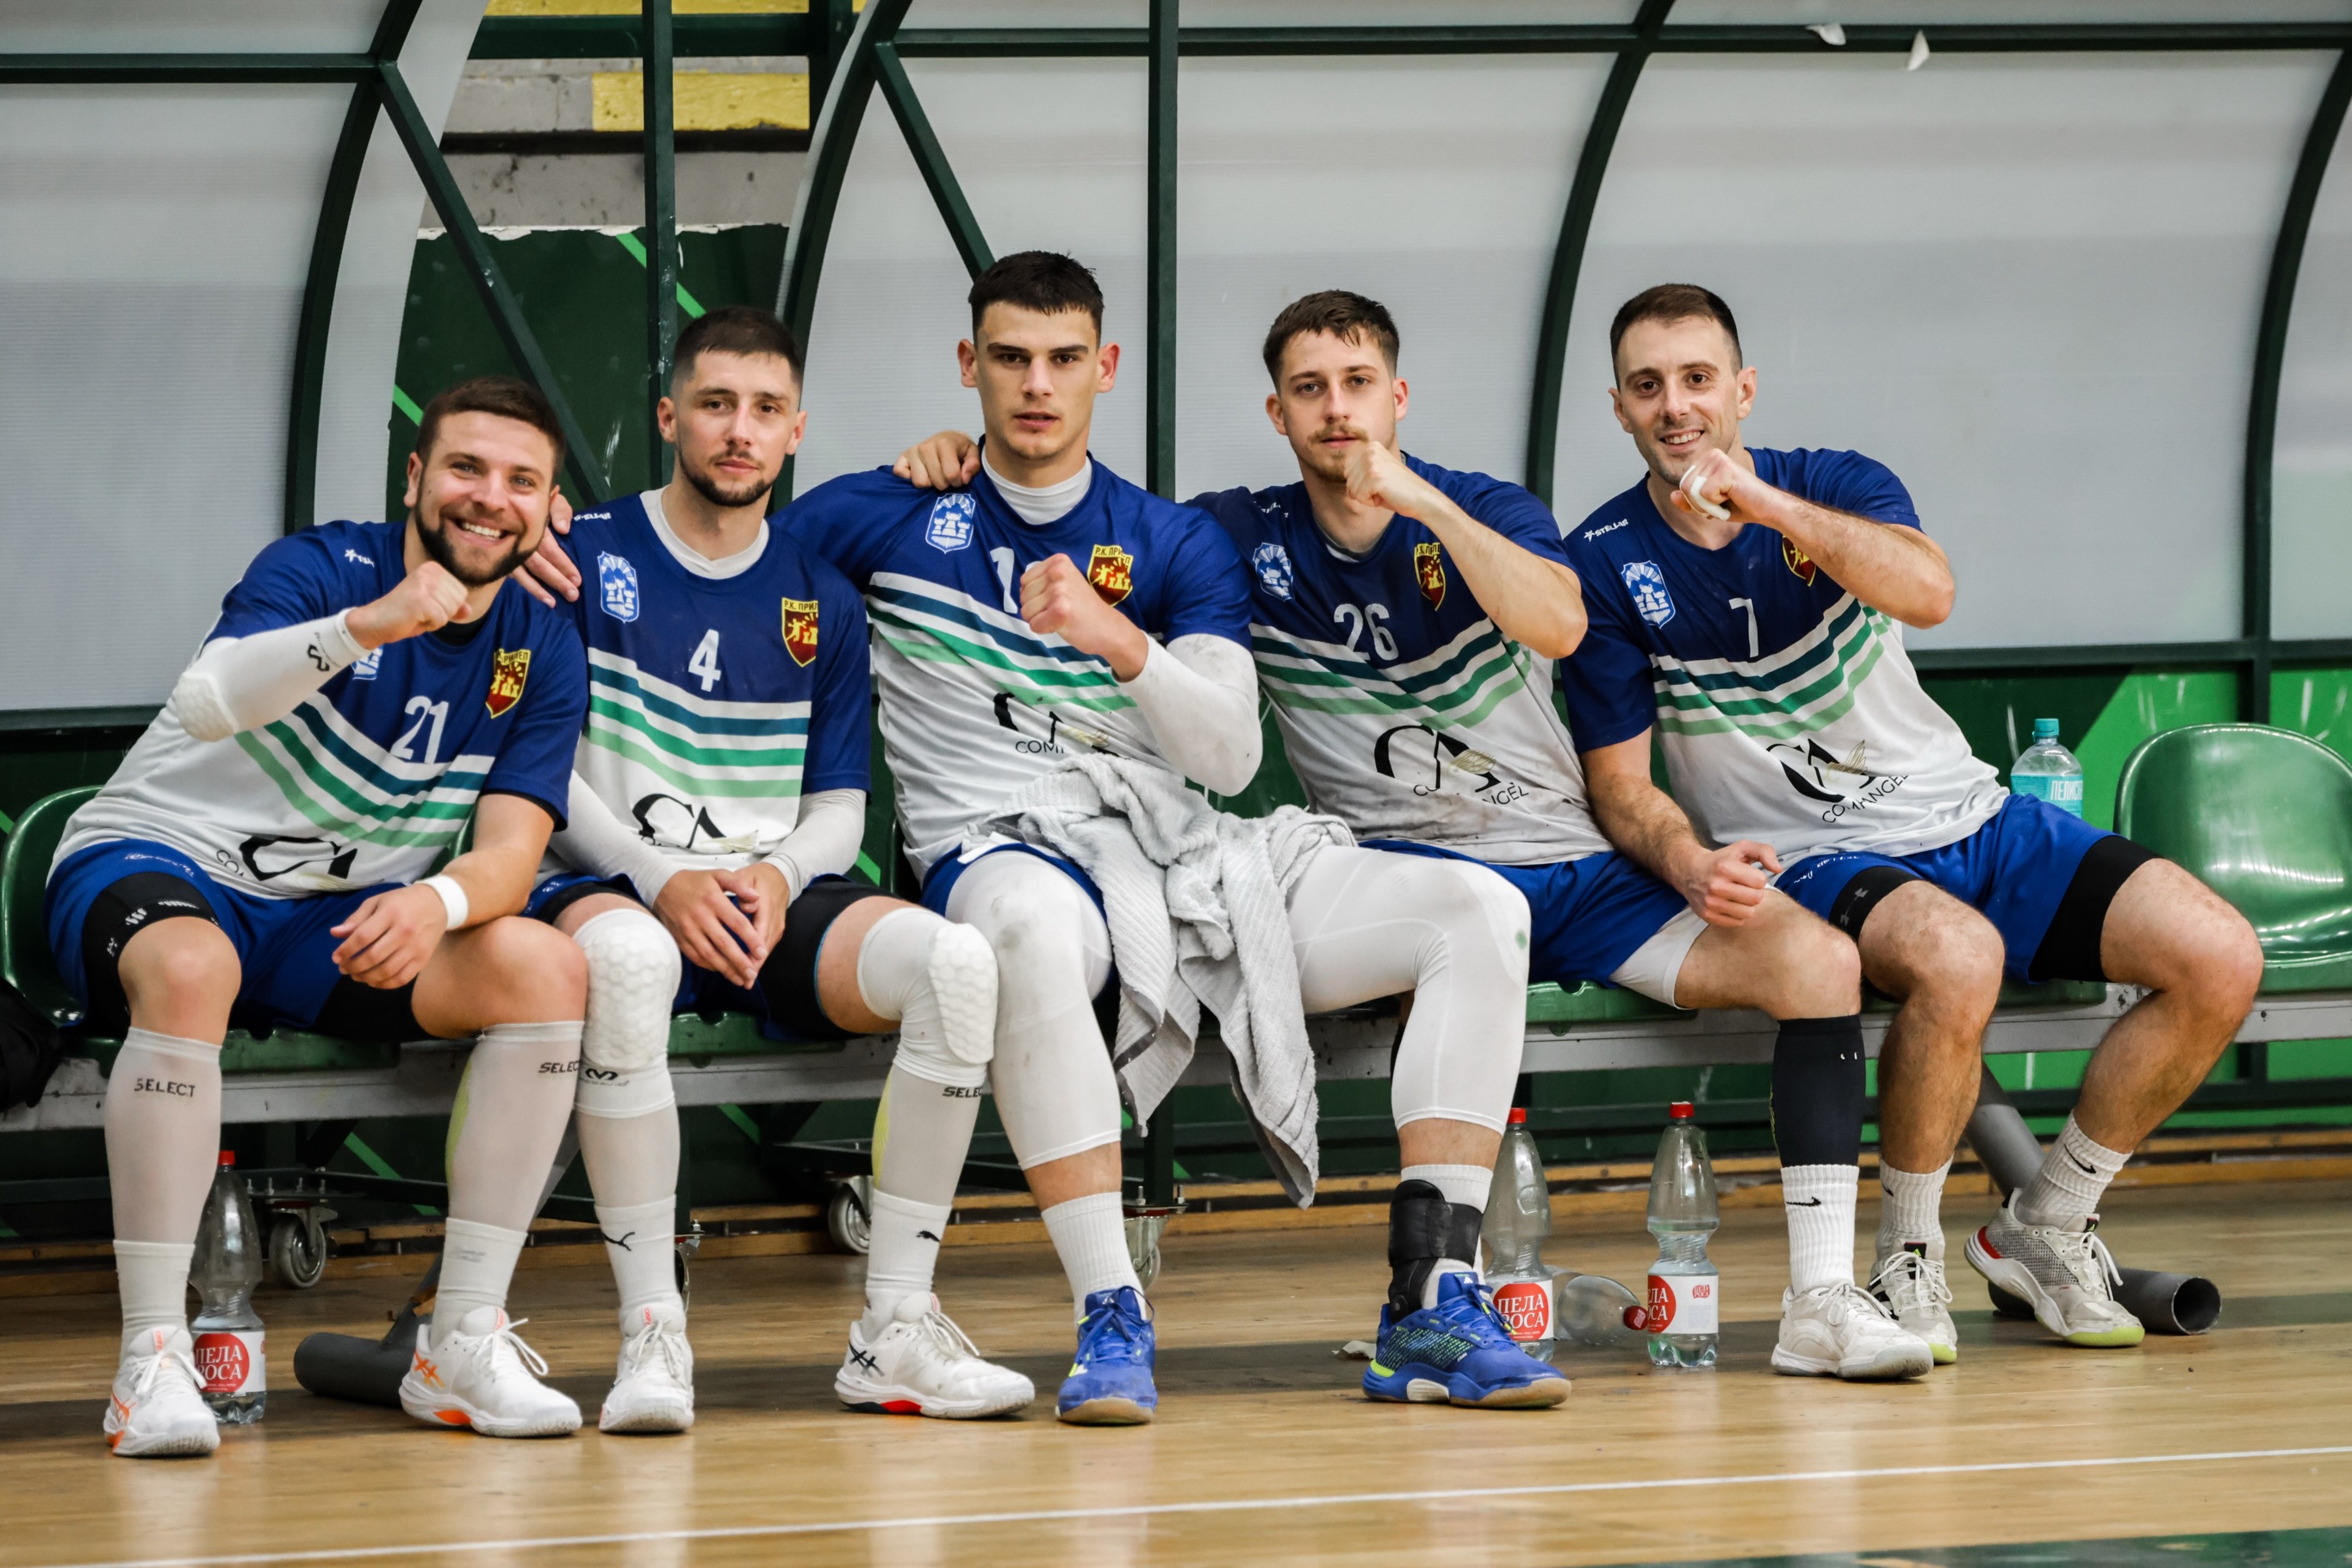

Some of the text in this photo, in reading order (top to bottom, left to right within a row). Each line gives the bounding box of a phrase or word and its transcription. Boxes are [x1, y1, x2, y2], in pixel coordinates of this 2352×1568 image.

[1594, 518, 1629, 537] STELLAR
[1333, 602, 1400, 662] 26
[1728, 597, 1759, 658] 7
[688, 628, 722, 693] 4
[389, 695, 450, 764] 21
[134, 1078, 196, 1098] SELECT
[1497, 1293, 1546, 1314] ПЕЛА
[195, 1345, 244, 1365] ПЕЛА
